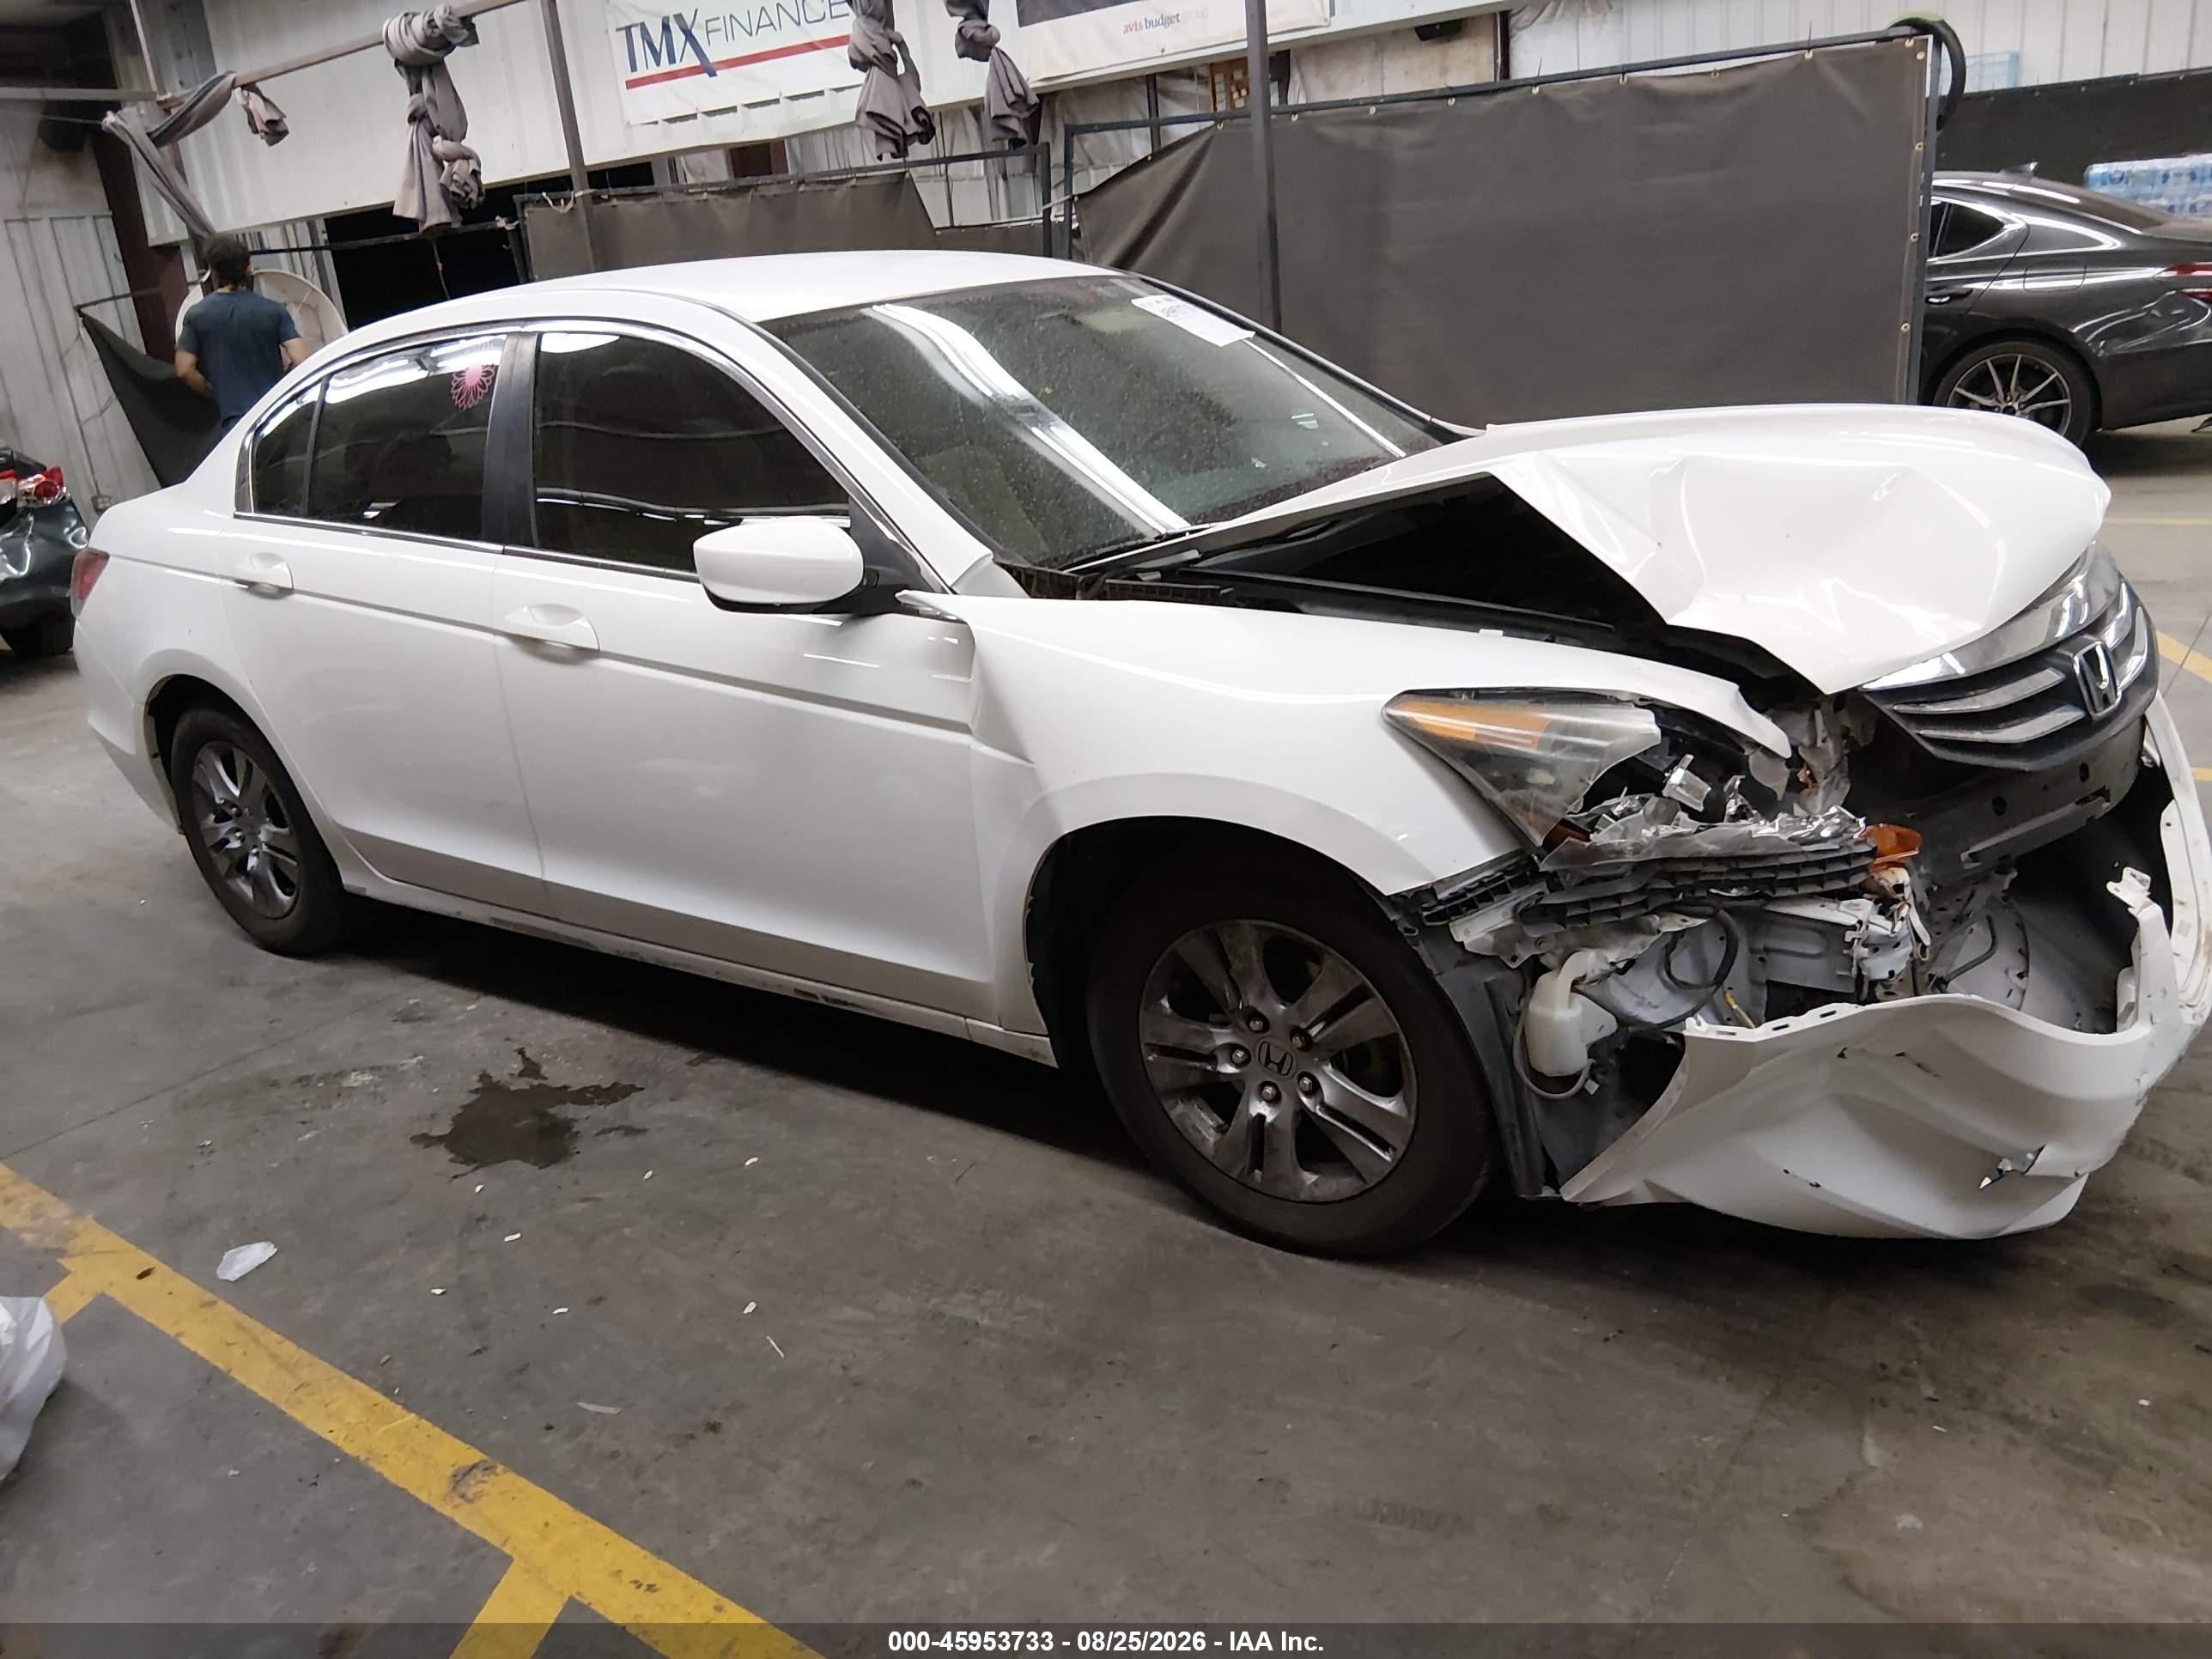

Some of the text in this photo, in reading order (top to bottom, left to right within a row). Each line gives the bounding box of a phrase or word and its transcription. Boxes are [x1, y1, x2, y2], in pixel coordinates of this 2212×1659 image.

[616, 0, 850, 77] TMX FINANCE
[1122, 20, 1144, 34] avis
[1145, 13, 1182, 30] budget
